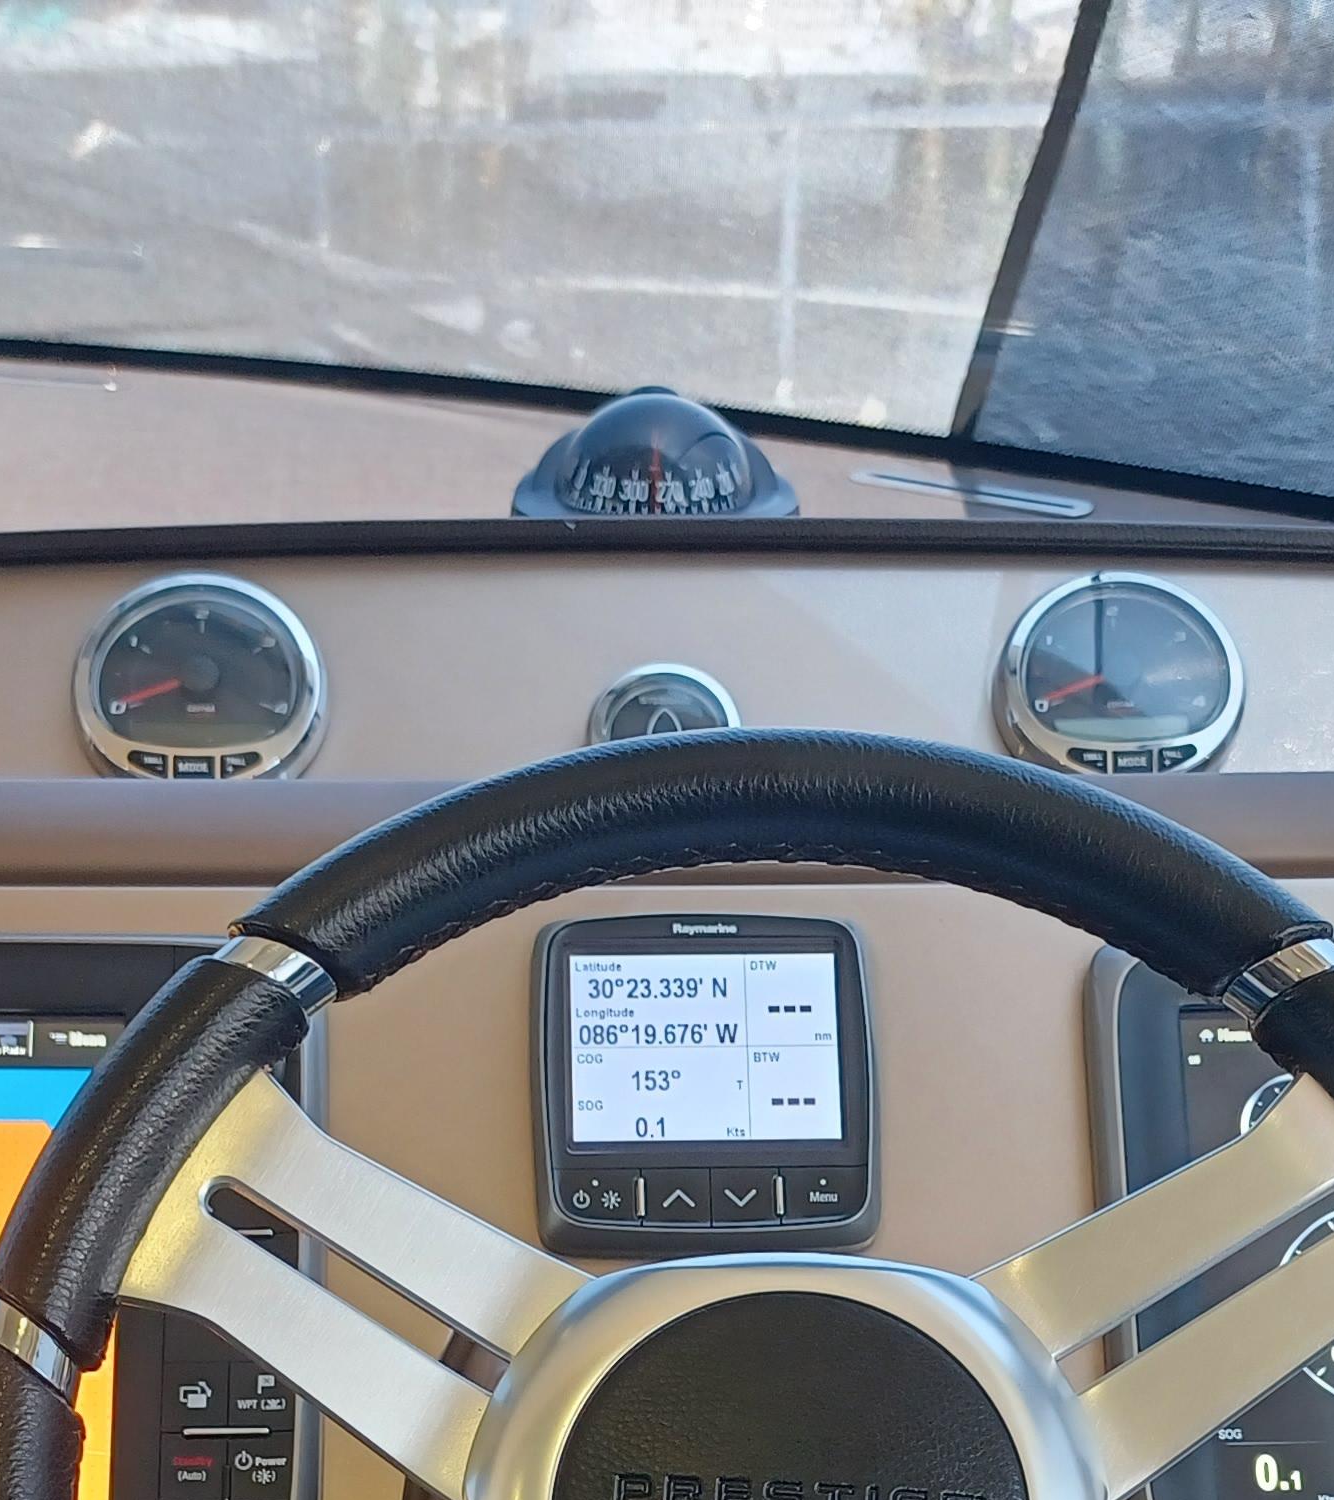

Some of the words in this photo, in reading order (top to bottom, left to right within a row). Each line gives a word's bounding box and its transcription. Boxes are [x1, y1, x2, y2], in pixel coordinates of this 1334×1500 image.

[672, 922, 738, 936] Raymarine
[574, 960, 622, 973] Latitude
[749, 960, 777, 971] DTW
[712, 977, 728, 999] N
[575, 1007, 635, 1020] Longitude
[716, 1023, 739, 1044] W
[814, 1031, 833, 1042] nm
[576, 1054, 604, 1065] COG
[753, 1052, 780, 1063] BTW
[631, 1069, 682, 1092] 153°
[736, 1080, 744, 1091] T
[577, 1100, 604, 1112] SOG
[635, 1117, 667, 1139] 0.1
[726, 1127, 746, 1138] Kts
[809, 1191, 839, 1204] Menu
[1218, 1428, 1243, 1441] SOG
[254, 1456, 288, 1467] Power
[1254, 1453, 1303, 1492] 0.1
